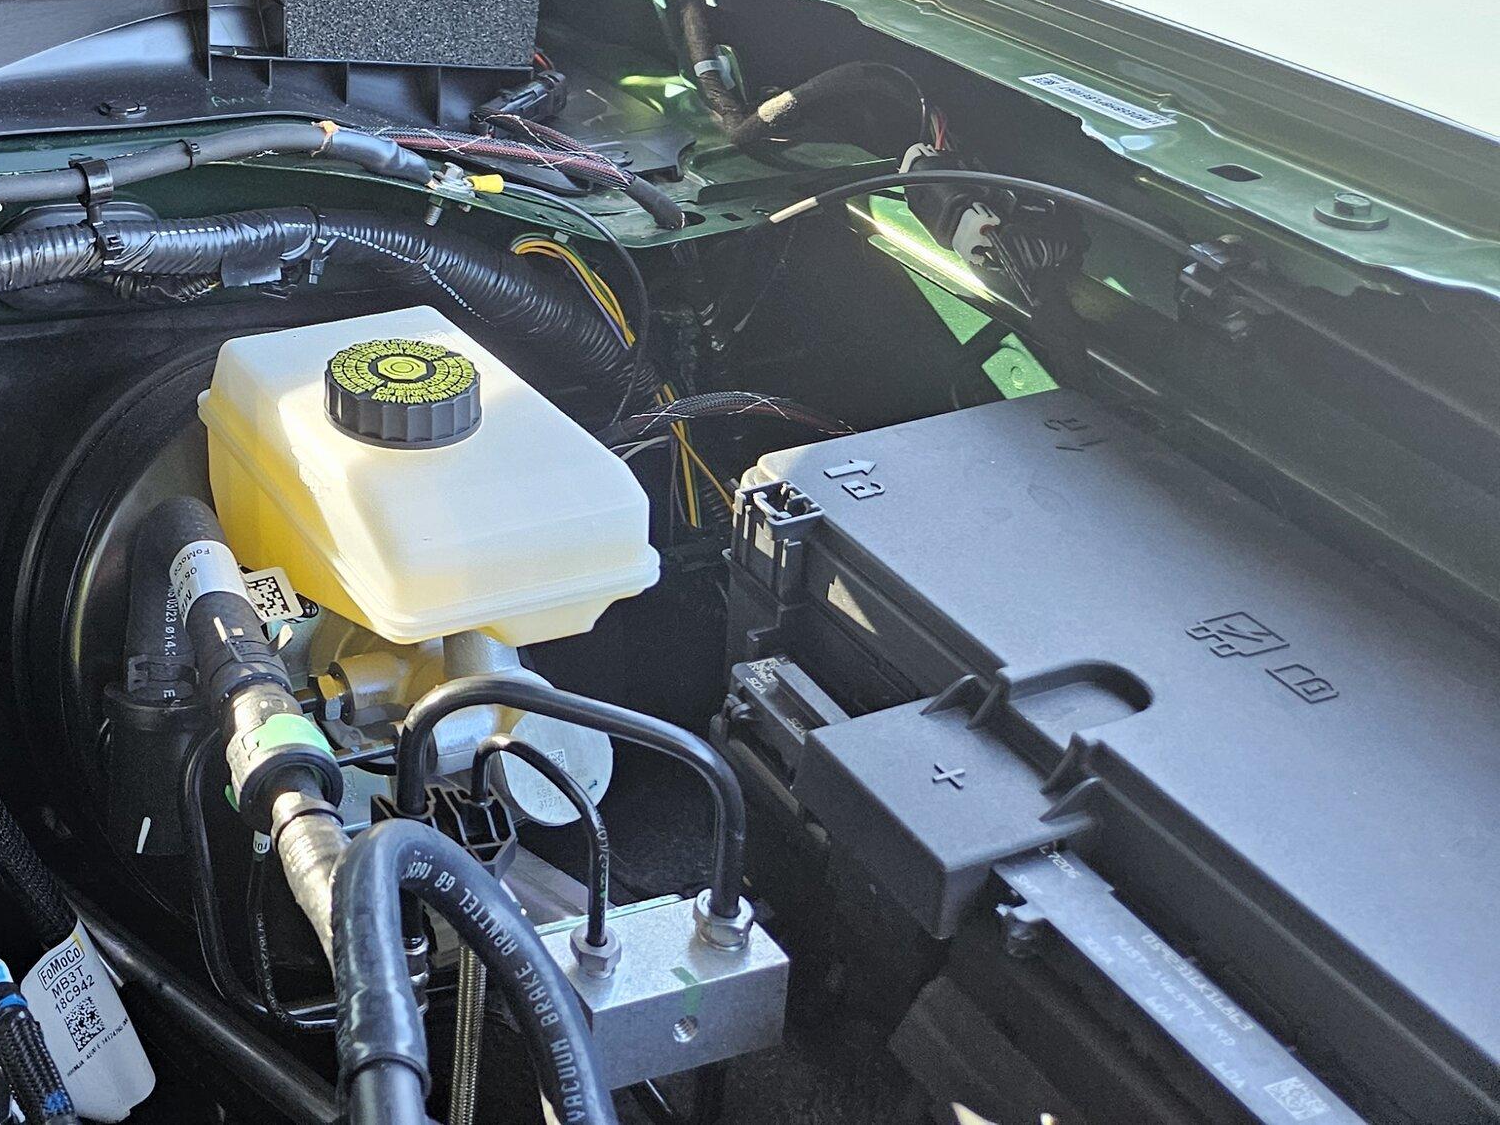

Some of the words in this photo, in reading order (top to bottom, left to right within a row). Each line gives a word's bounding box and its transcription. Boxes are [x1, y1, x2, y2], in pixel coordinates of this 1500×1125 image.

[458, 887, 519, 957] ARNITEL
[40, 945, 82, 985] FoMoCo
[51, 964, 86, 1000] MB3T
[54, 974, 95, 1015] 18C942
[516, 961, 560, 1028] BRAKE
[550, 1037, 586, 1123] VACUUM
